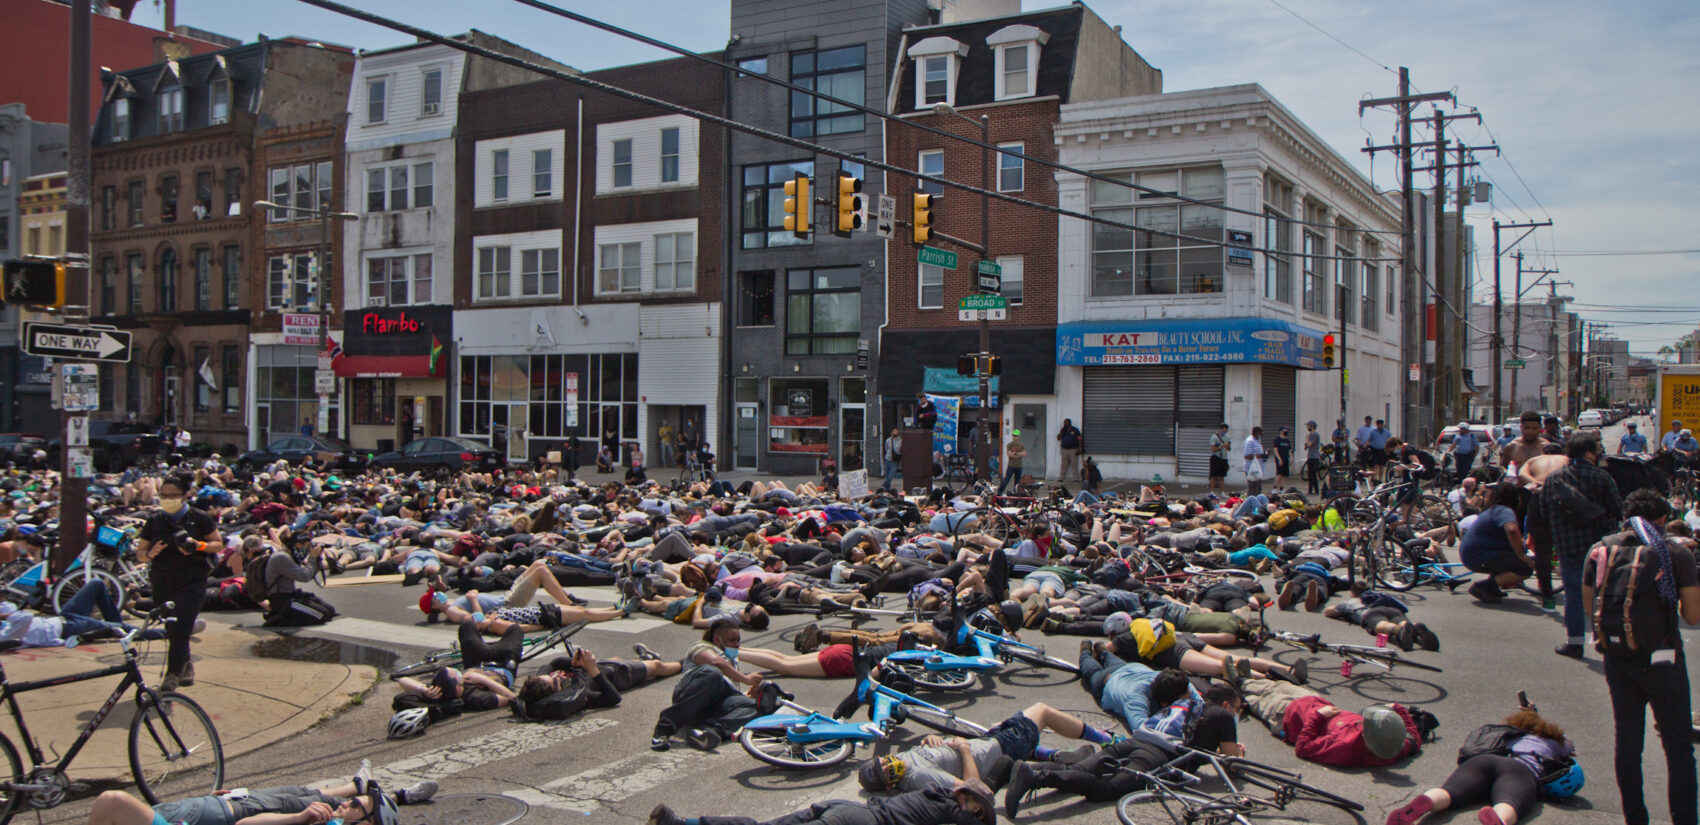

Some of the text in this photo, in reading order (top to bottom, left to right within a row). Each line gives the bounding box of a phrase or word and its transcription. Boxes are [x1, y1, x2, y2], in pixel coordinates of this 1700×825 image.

[881, 198, 893, 210] ONE
[880, 210, 893, 220] WAY
[921, 250, 955, 266] Parrish St
[967, 299, 995, 308] BROAD
[964, 311, 970, 319] S
[995, 310, 1001, 318] N
[292, 315, 320, 326] RENT
[363, 312, 418, 334] Flambo
[39, 334, 100, 350] ONE WAY
[1102, 333, 1140, 346] KAT
[1159, 332, 1189, 345] BEAUTY
[1228, 330, 1245, 344] INC.
[1103, 355, 1159, 363] 215-763-2860
[1163, 353, 1244, 362] FAX: 215-922-4980
